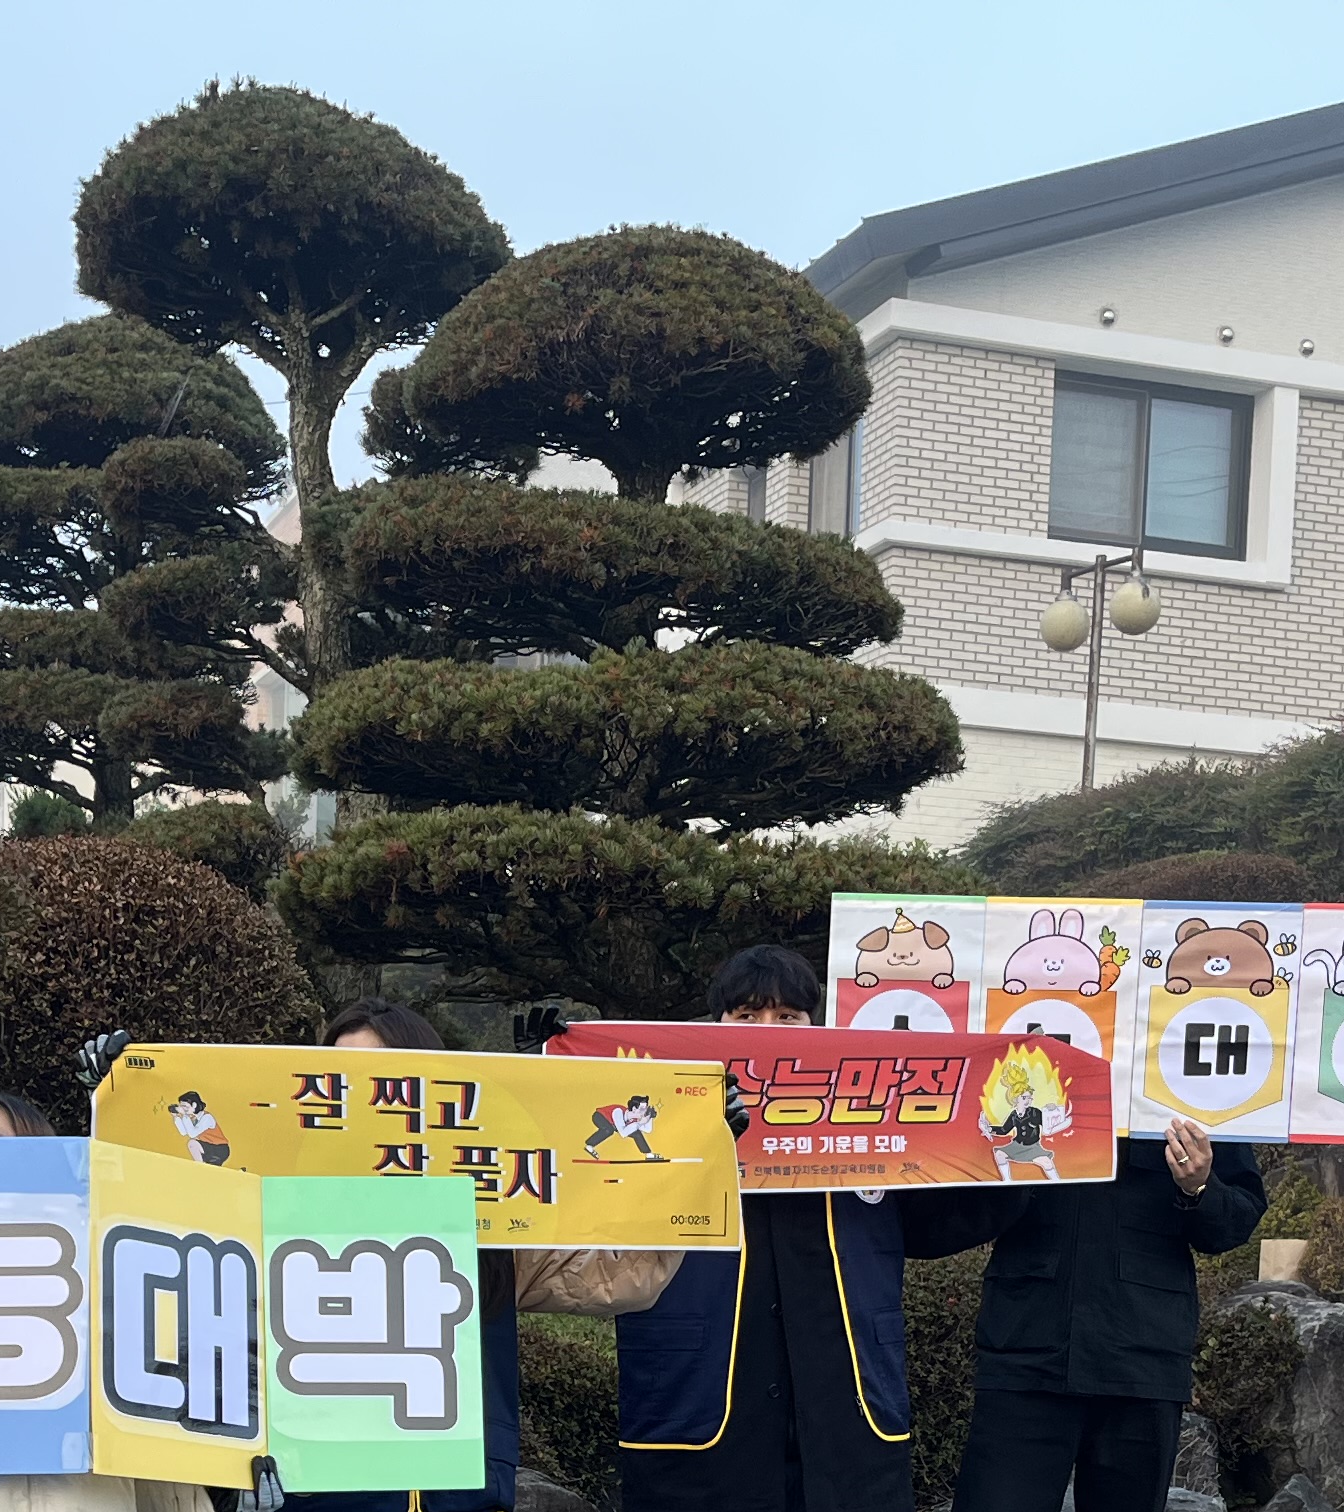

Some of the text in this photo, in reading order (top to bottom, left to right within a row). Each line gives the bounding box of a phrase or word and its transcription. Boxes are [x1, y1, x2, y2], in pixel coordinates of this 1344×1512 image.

[290, 1072, 485, 1134] 잘 찍고
[683, 1085, 709, 1098] REC
[762, 1134, 908, 1155] 우주의 기운을 모아
[449, 1144, 563, 1205] 풀자
